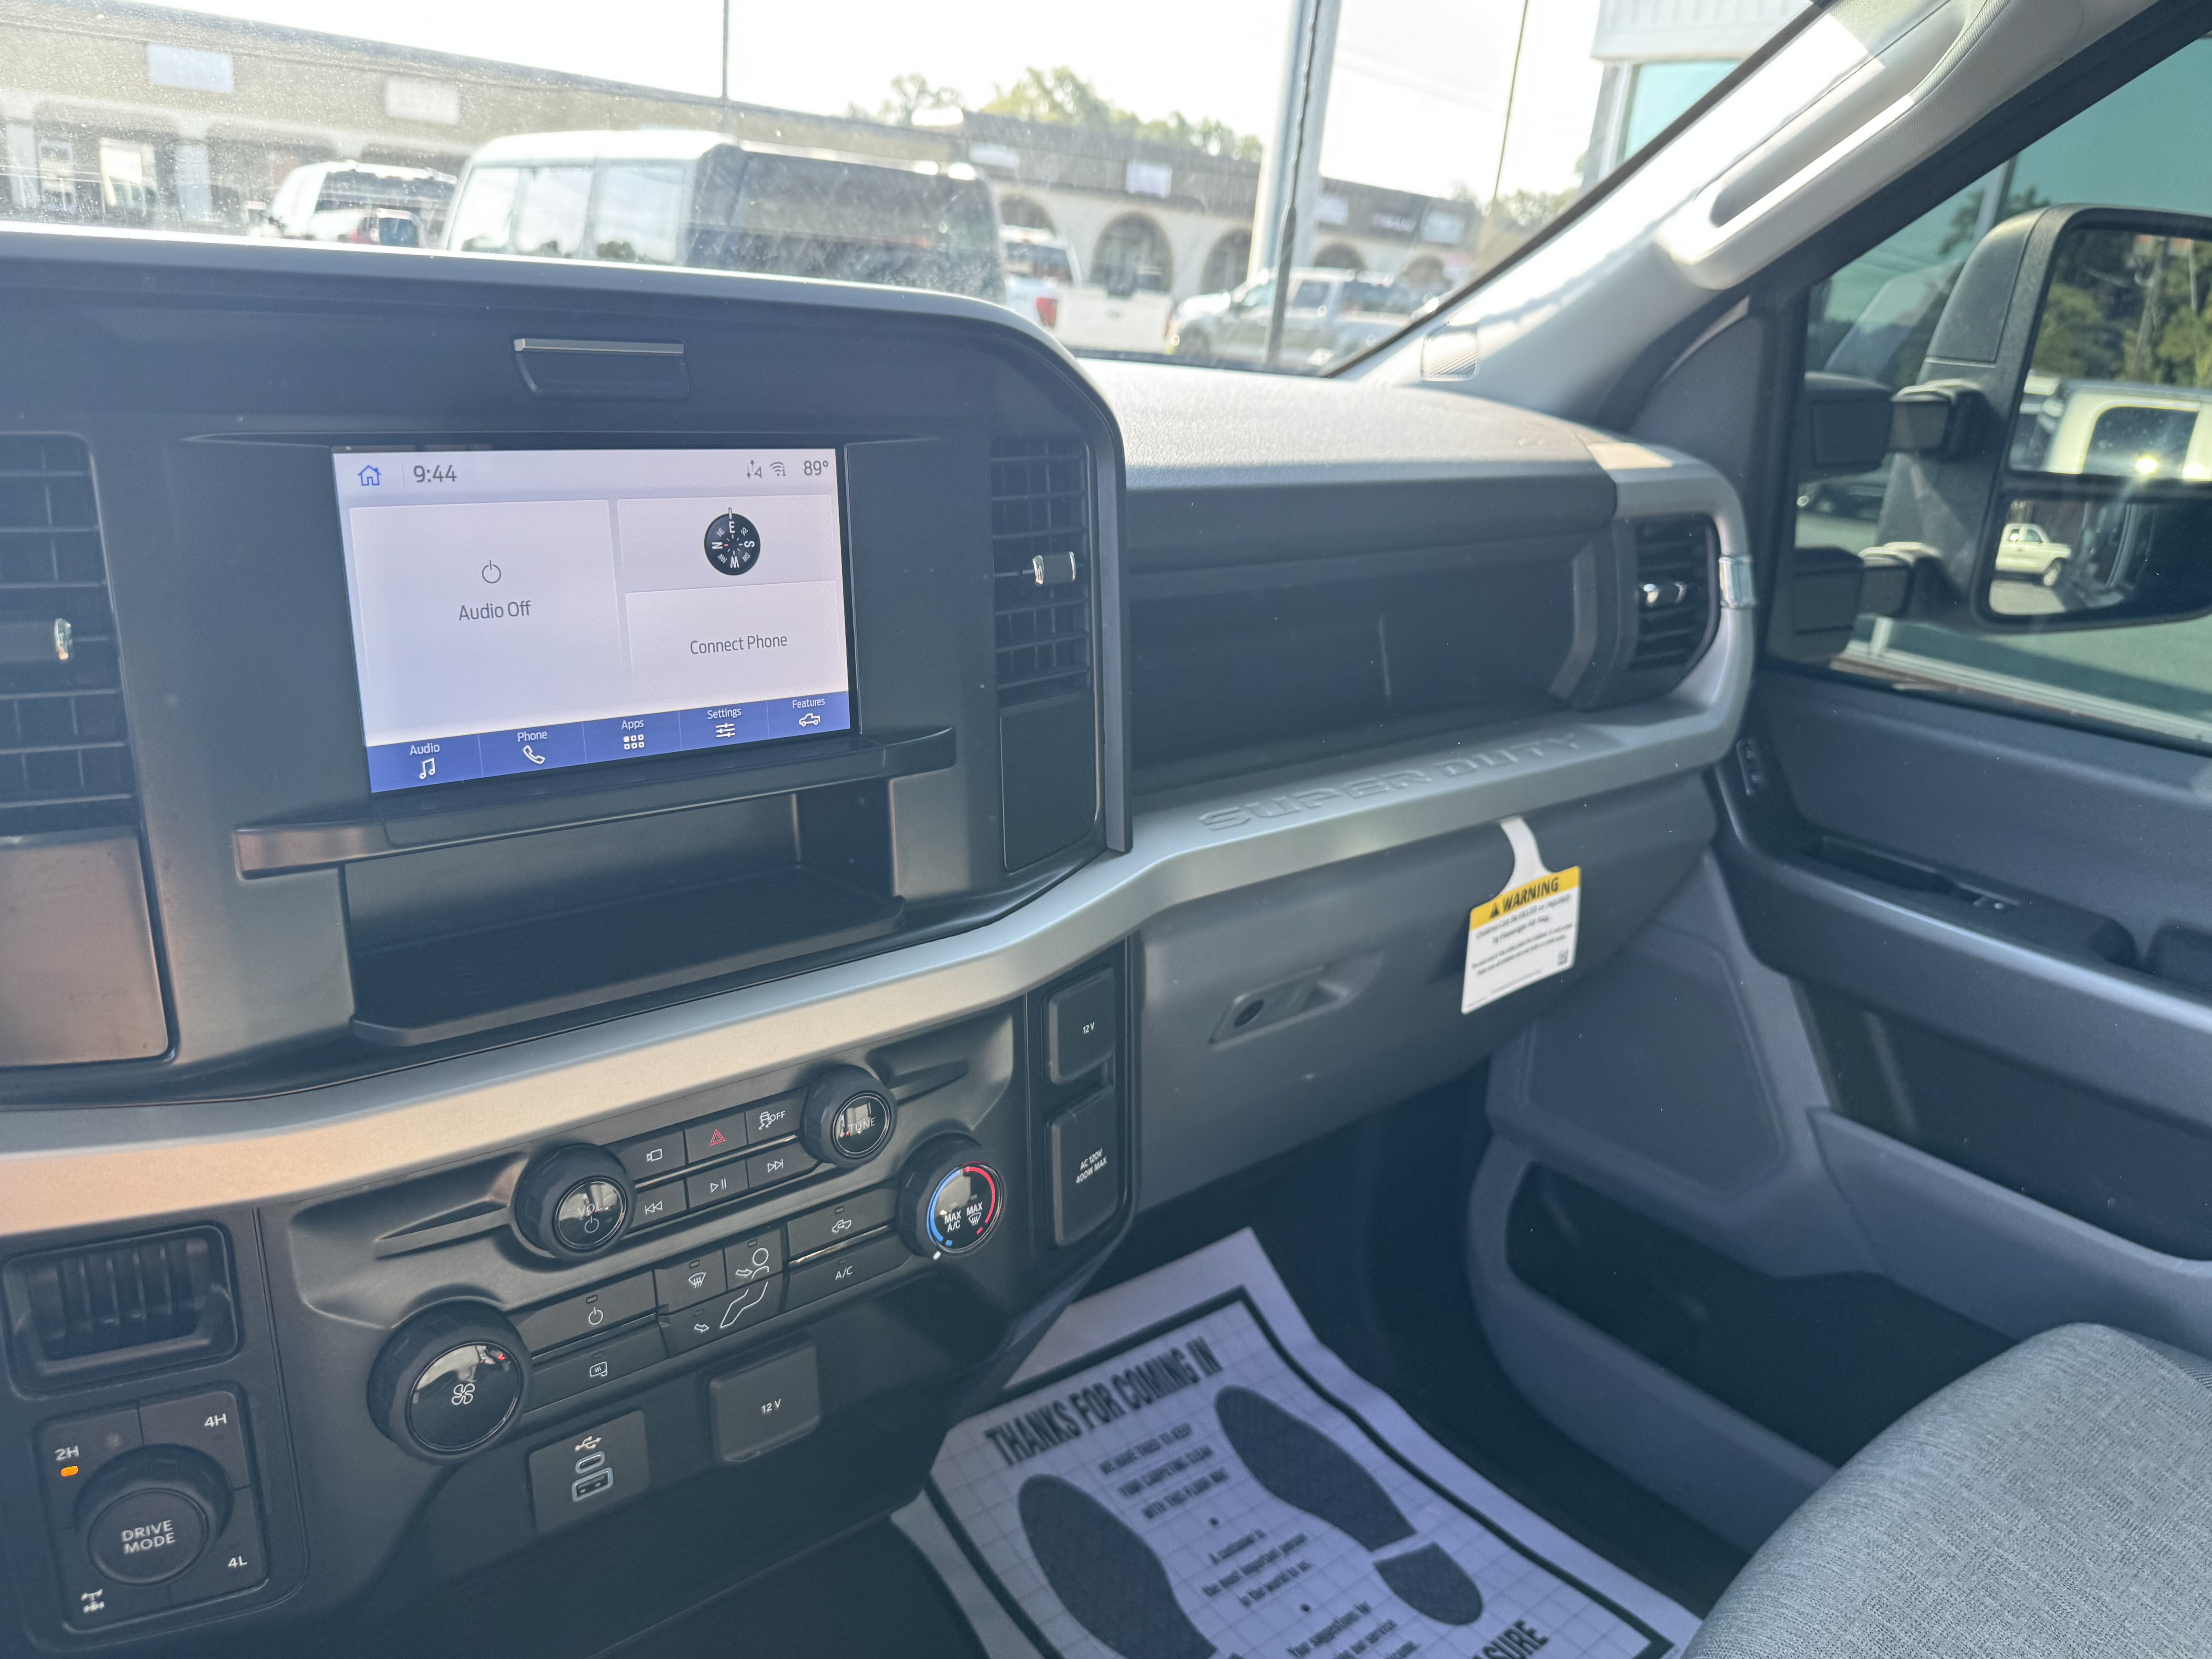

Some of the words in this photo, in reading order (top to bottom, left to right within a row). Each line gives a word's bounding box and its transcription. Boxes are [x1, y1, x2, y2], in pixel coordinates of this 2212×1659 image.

[413, 464, 457, 483] 9:44
[804, 460, 828, 476] 89°
[729, 521, 735, 533] E
[730, 556, 740, 568] W
[459, 603, 504, 621] Audio
[508, 600, 531, 617] Off
[690, 638, 745, 655] Connect
[746, 634, 788, 651] Phone
[792, 697, 826, 709] Features
[707, 706, 742, 721] Settings
[621, 717, 644, 731] Apps
[517, 728, 548, 742] Phone
[409, 740, 440, 756] Audio
[1199, 769, 1432, 831] SUPER
[1433, 732, 1579, 778] DUTY
[1503, 877, 1559, 912] WARNING
[770, 1110, 786, 1122] OFF
[848, 1117, 876, 1132] TUNE
[1080, 1158, 1089, 1171] AC
[1088, 1148, 1103, 1165] 120V
[1075, 1168, 1094, 1183] 400W
[1094, 1156, 1107, 1172] MAX
[577, 1202, 604, 1216] VOL
[966, 1202, 983, 1216] MAX
[944, 1210, 961, 1224] MAX
[947, 1219, 961, 1233] A/C
[835, 1266, 853, 1280] A/C
[761, 1402, 773, 1413] 12
[773, 1398, 781, 1409] V
[984, 1400, 1082, 1467] THANKS
[1069, 1382, 1126, 1430] FOR
[1111, 1347, 1200, 1410] COMING
[1186, 1335, 1223, 1378] IN
[204, 1413, 227, 1427] 4H
[55, 1446, 80, 1461] 2H
[121, 1520, 173, 1542] DRIVE
[124, 1532, 176, 1554] MODE
[228, 1555, 248, 1568] 4L
